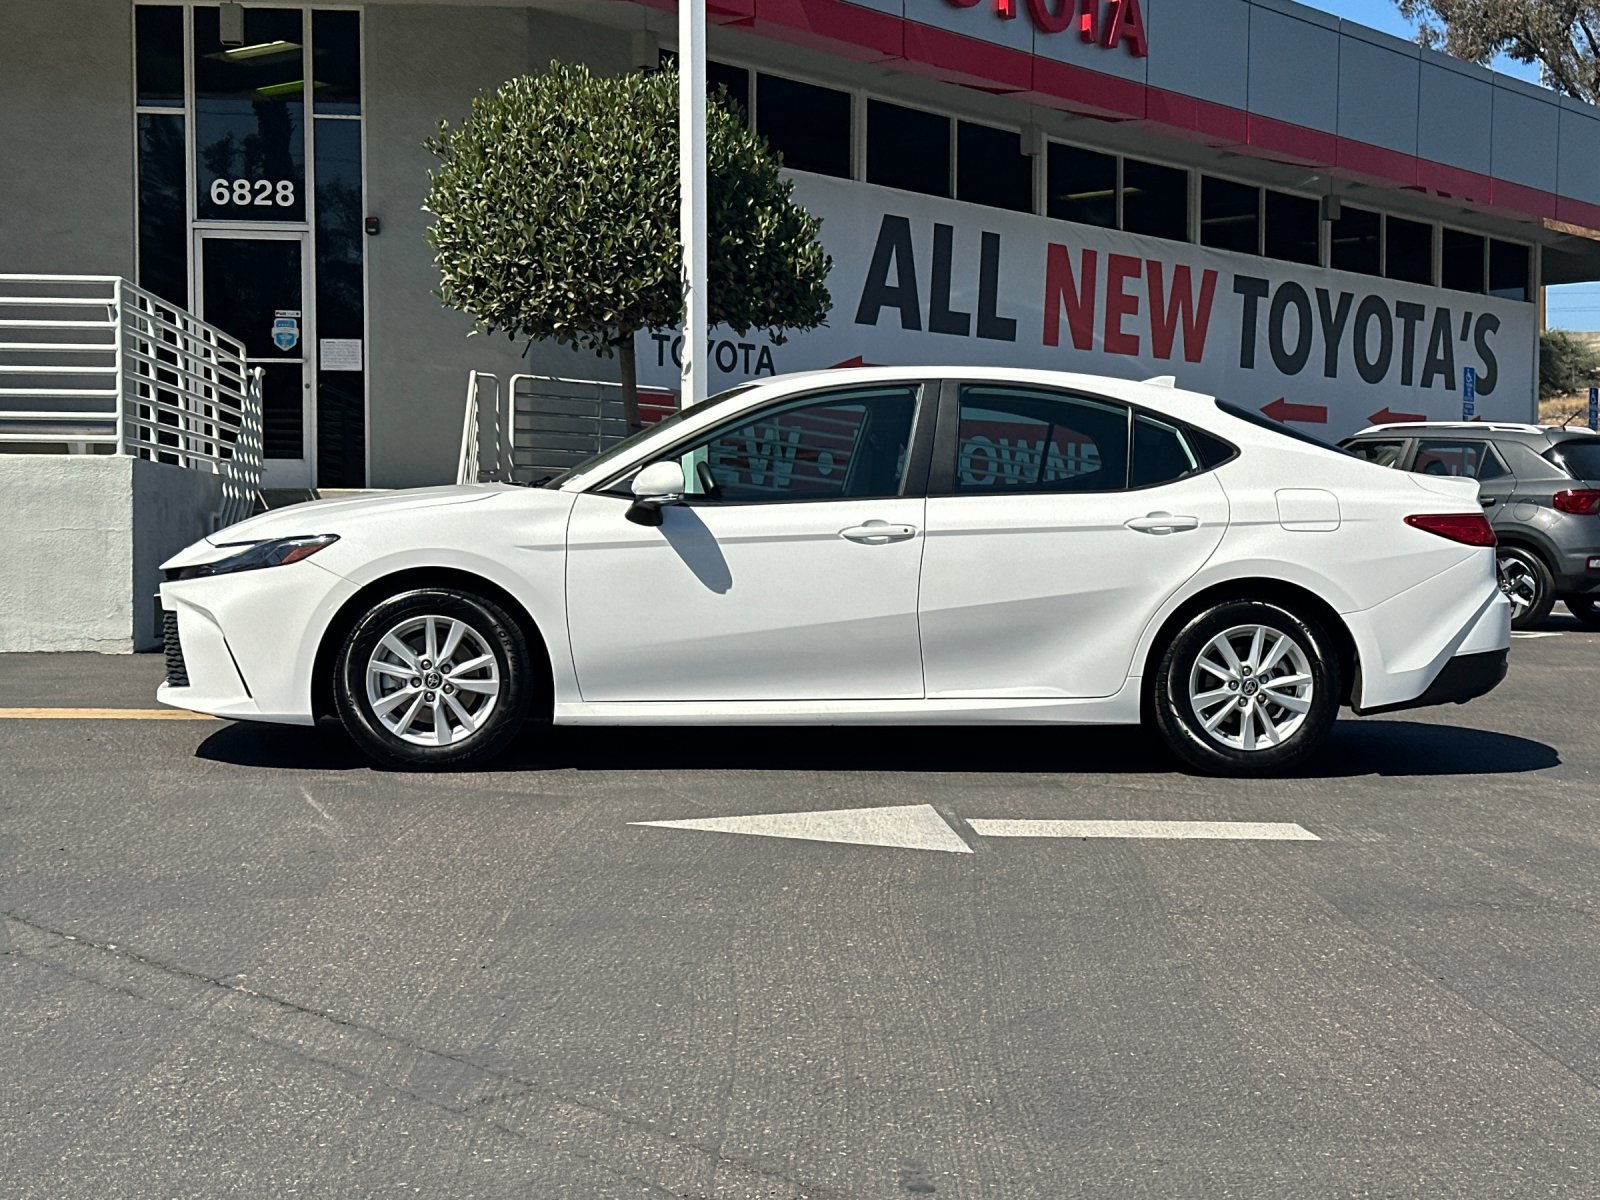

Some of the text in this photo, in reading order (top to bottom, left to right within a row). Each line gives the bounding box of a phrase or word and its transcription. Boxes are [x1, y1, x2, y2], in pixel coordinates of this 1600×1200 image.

[210, 178, 295, 207] 6828
[854, 213, 1501, 396] ALL NEW TOYOTA'S
[651, 333, 776, 376] TOOTA
[961, 435, 1102, 486] OWNE
